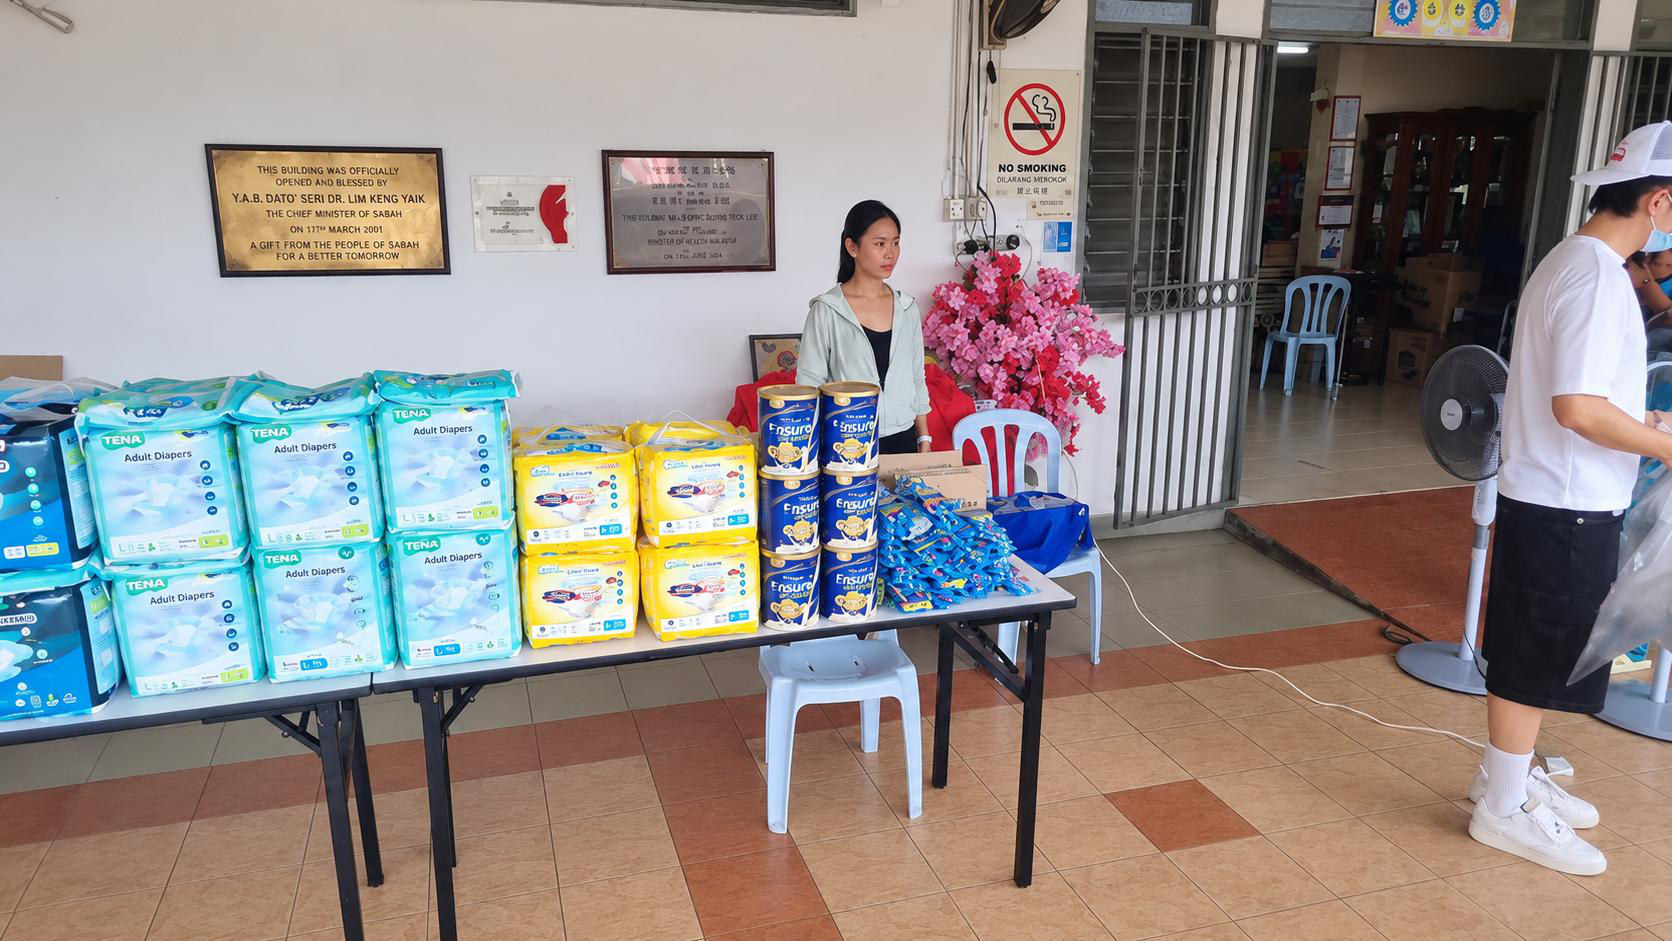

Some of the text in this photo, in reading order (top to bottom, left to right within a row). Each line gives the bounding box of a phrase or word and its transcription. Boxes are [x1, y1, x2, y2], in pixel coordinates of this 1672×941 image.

[257, 166, 399, 175] THIS BUILDING WAS OFFICIALLY
[998, 164, 1066, 172] NO SMOKING
[275, 178, 312, 187] OPENED
[336, 179, 374, 187] BLESSED
[377, 179, 388, 187] BY
[232, 193, 263, 203] Y.A.B.
[301, 194, 324, 204] SERI
[328, 194, 346, 204] DR.
[348, 194, 366, 204] LIM
[370, 194, 398, 204] KENG
[402, 194, 425, 204] YAIK
[266, 210, 284, 218] THE
[364, 225, 383, 234] 2001
[259, 242, 280, 250] GIFT
[284, 241, 310, 249] FROM
[335, 241, 370, 249] PEOPLE
[388, 240, 419, 249] SABAH
[276, 252, 296, 260] FOR
[345, 251, 400, 260] TOMORROW
[393, 408, 429, 419] TENA
[251, 428, 290, 438] TENA
[413, 424, 473, 436] Adult Diapers
[103, 435, 143, 445] TENA
[274, 441, 337, 454] Adult Diapers
[124, 450, 192, 462] Adult Diapers
[404, 540, 439, 550] TENA
[265, 554, 299, 564] TENA
[424, 552, 482, 565] Adult Diapers
[285, 566, 345, 578] Adult Diapers
[126, 580, 166, 590] TENA
[150, 591, 214, 605] Adult Diapers
